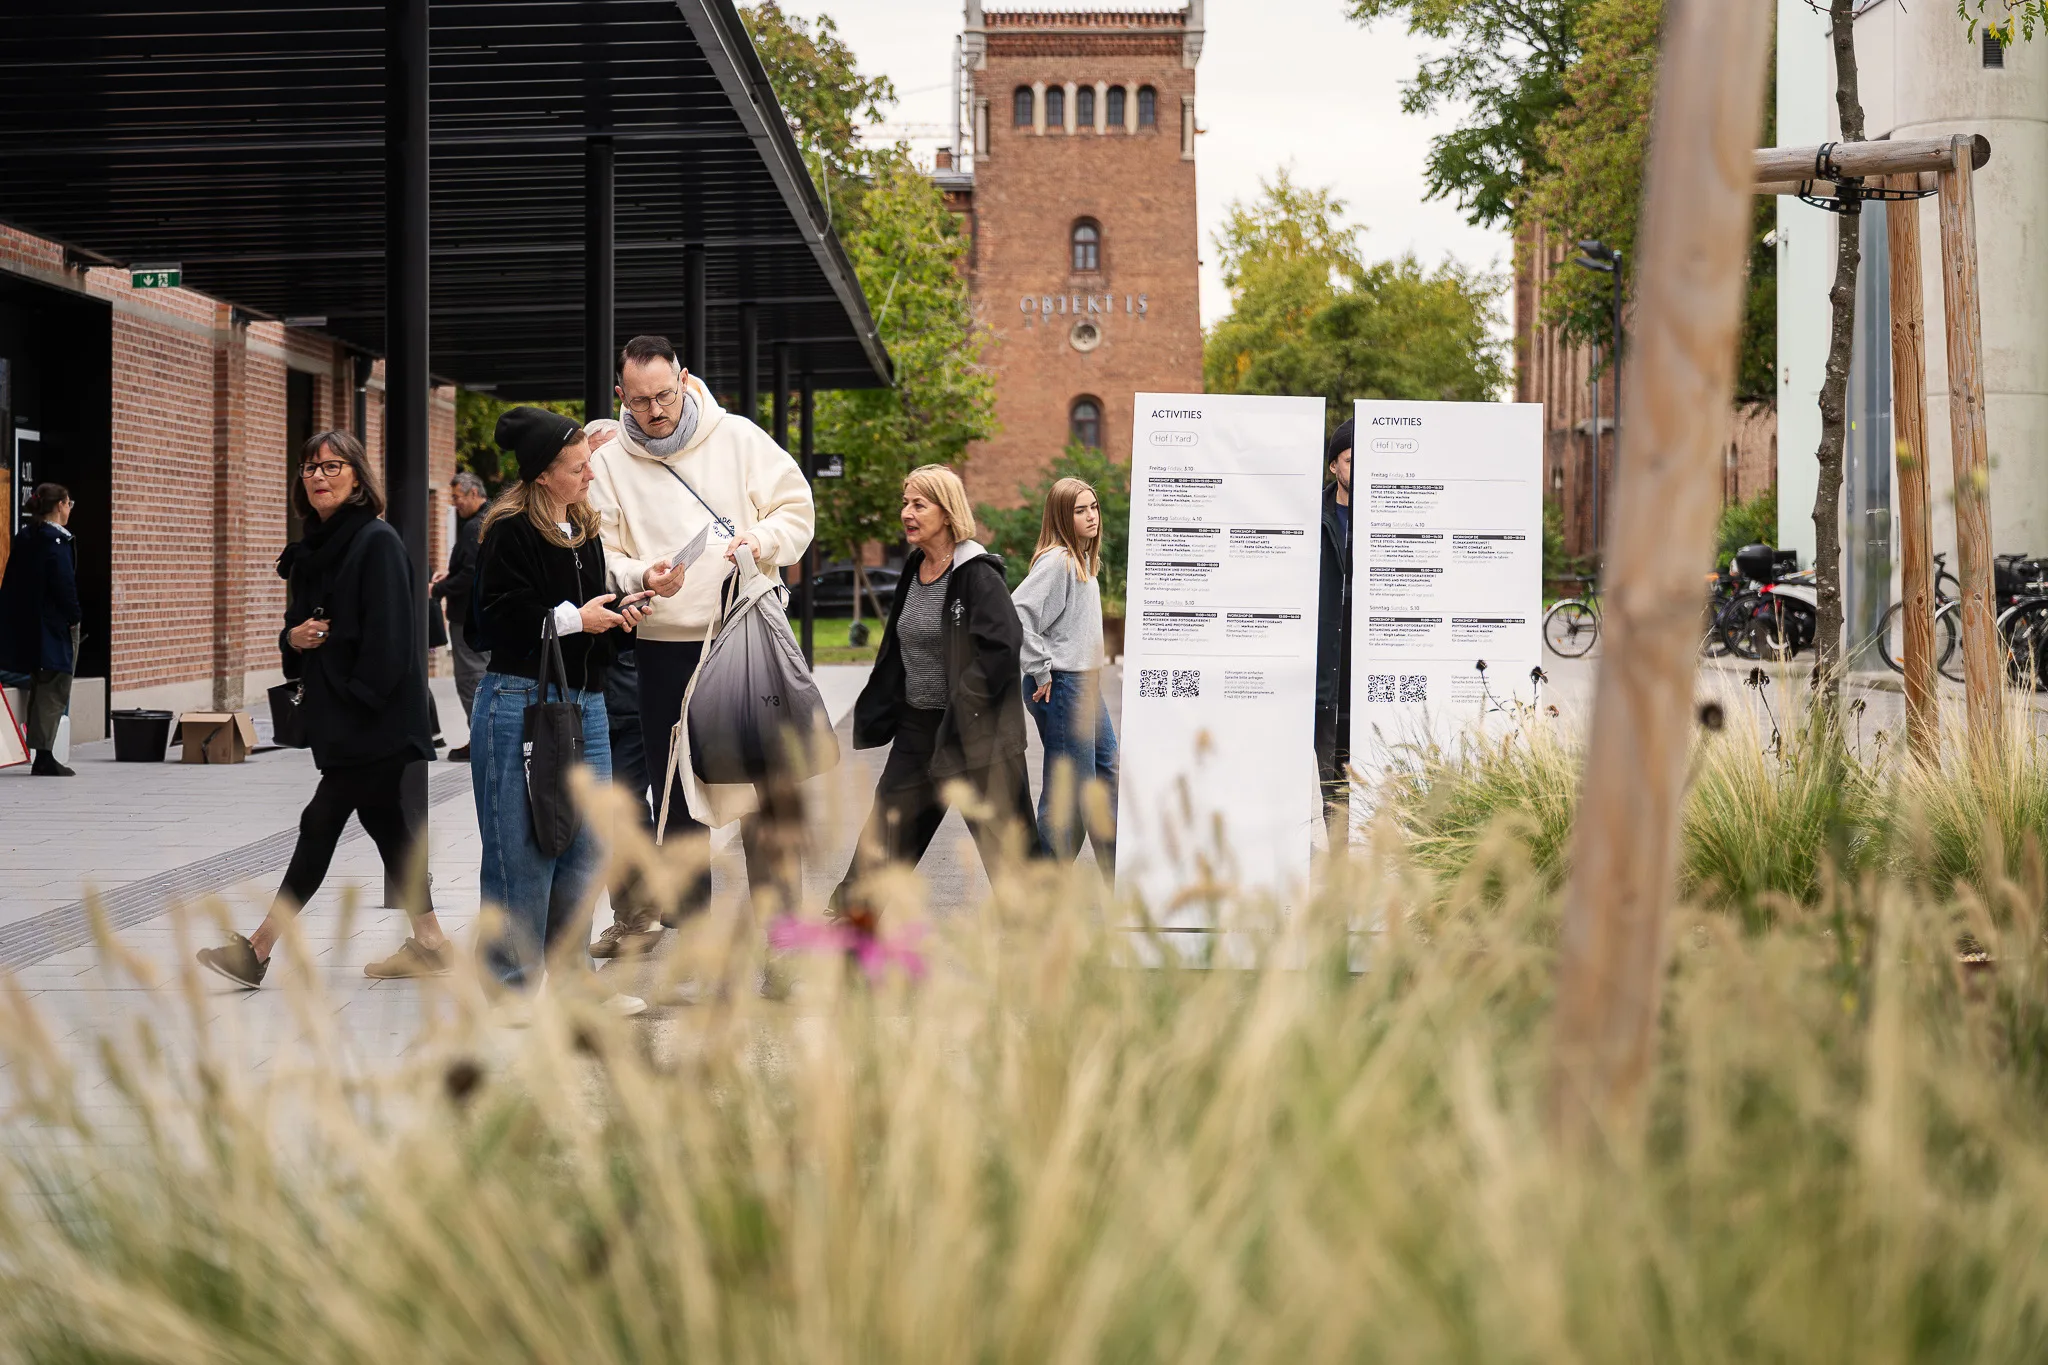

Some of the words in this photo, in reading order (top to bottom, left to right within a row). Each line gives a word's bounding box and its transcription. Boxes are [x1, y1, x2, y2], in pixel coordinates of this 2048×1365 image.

[1020, 294, 1113, 314] OBJEKT
[1152, 410, 1202, 419] ACTIVITIES
[1372, 417, 1422, 426] ACTIVITIES
[1175, 435, 1191, 443] Yard
